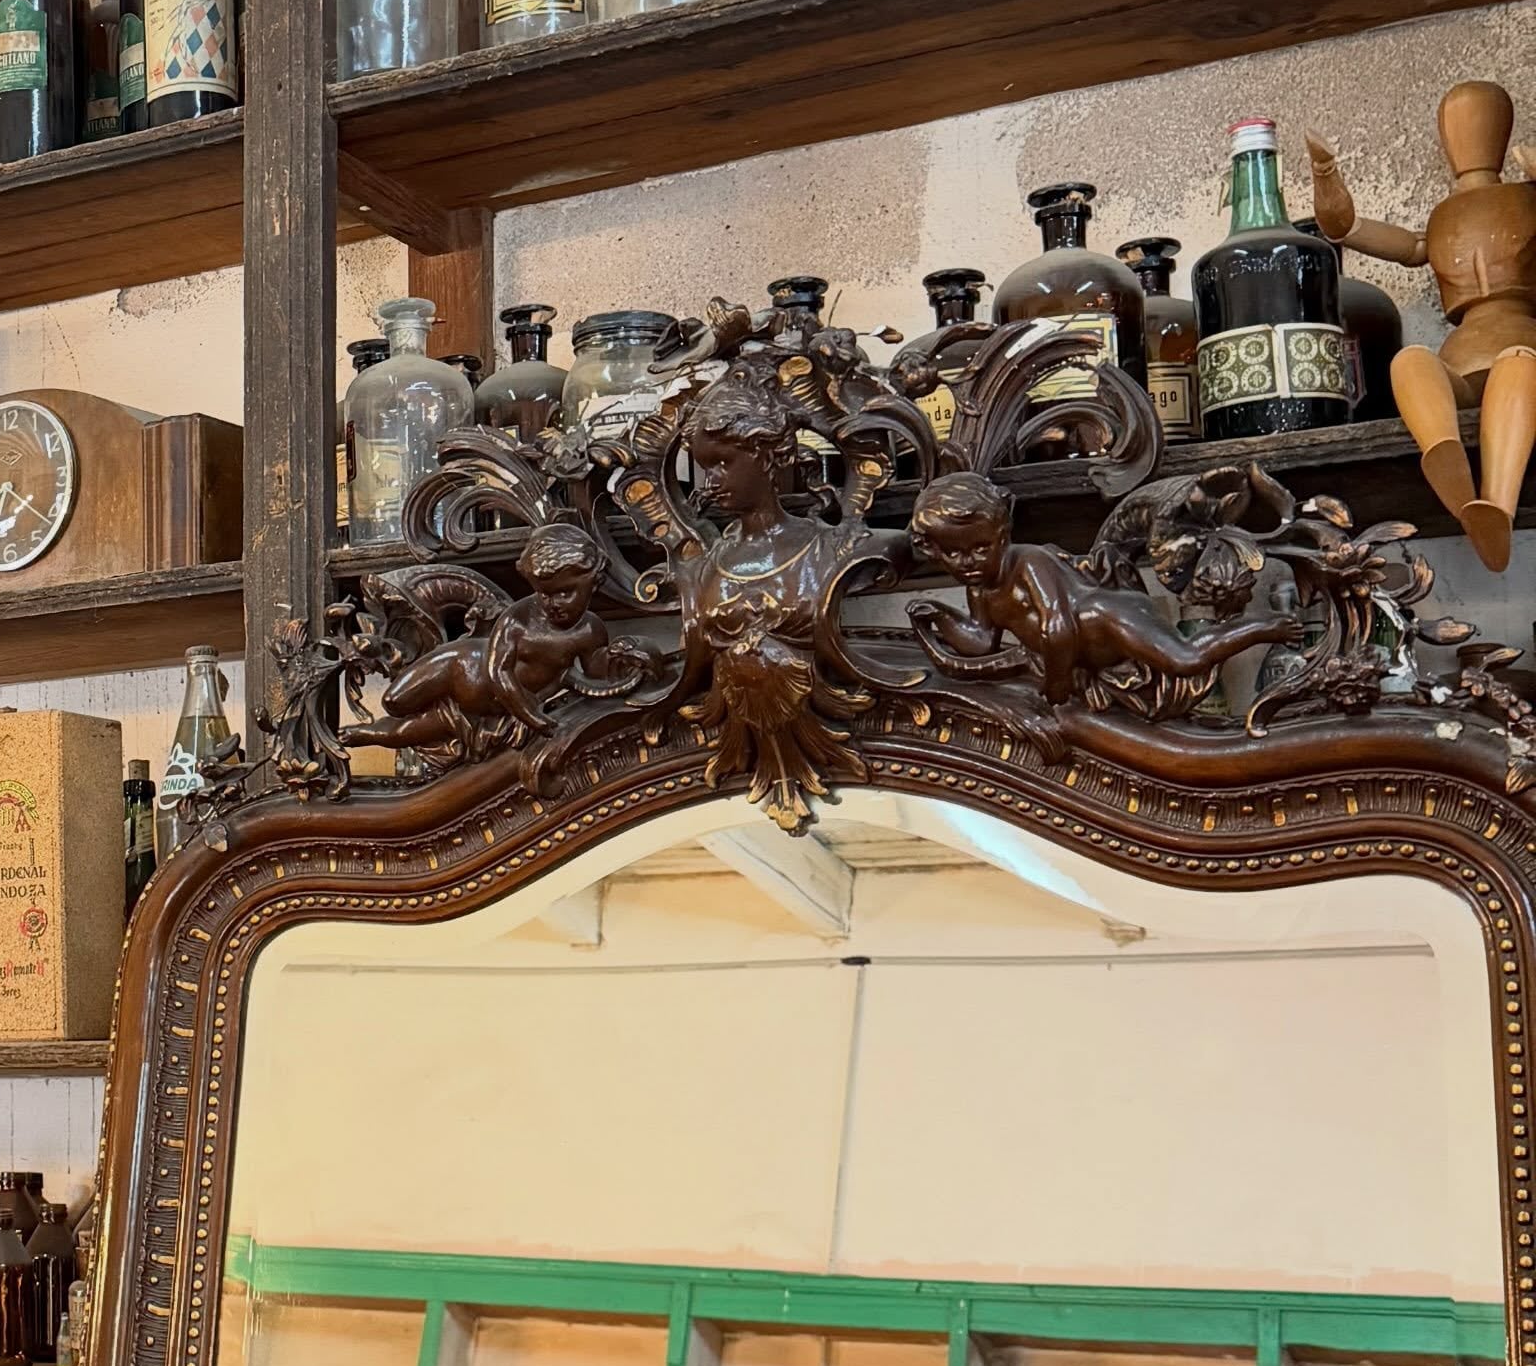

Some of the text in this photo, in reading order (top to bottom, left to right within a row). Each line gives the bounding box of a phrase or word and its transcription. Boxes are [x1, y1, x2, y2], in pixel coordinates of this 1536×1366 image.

[2, 409, 19, 431] 12
[31, 412, 38, 432] 1
[2, 543, 18, 563] 6
